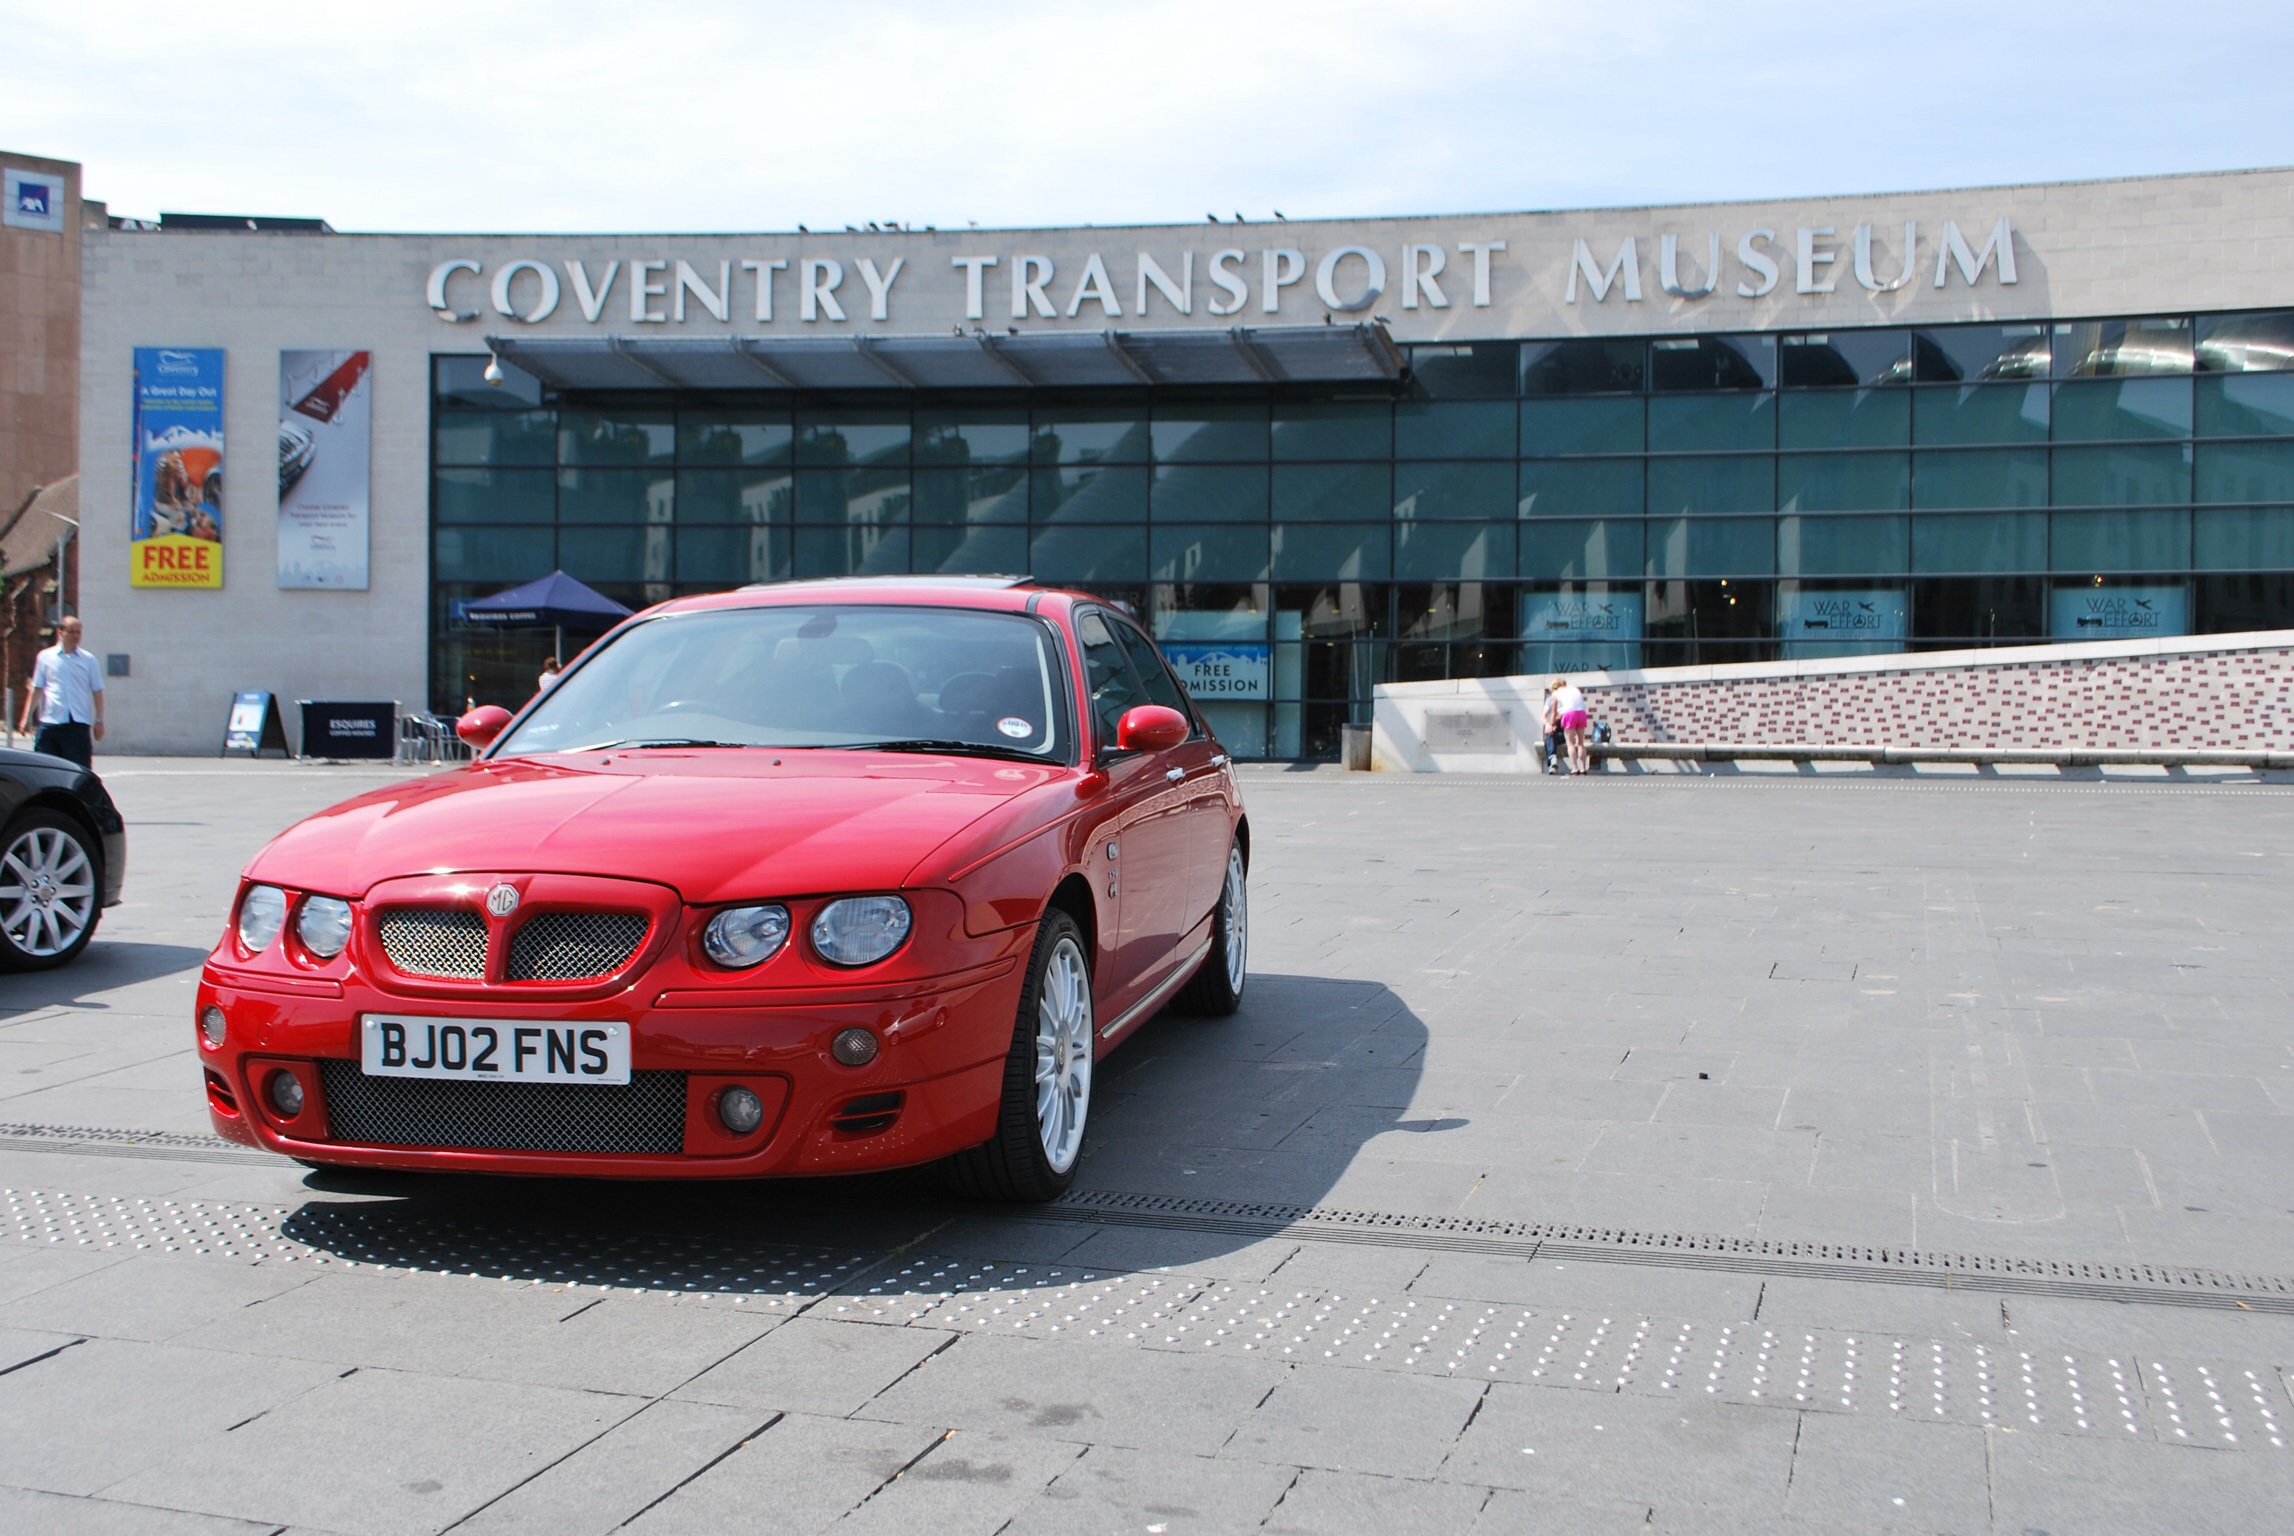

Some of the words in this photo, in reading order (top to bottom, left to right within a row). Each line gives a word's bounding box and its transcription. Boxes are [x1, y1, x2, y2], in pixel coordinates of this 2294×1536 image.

[425, 258, 906, 324] COVENTRY
[951, 241, 1507, 320] TRANSPORT
[1565, 216, 2019, 304] MUSEUM
[143, 545, 210, 571] FREE
[143, 573, 210, 583] ADMISSION
[1094, 590, 1196, 611] NTRNCE
[1813, 601, 1851, 616] WAR
[2086, 598, 2126, 614] WAR
[1554, 601, 1590, 617] WAR
[1570, 615, 1621, 630] EFFORT
[1830, 614, 1883, 630] EFFORT
[2104, 611, 2161, 627] EFFORT
[1195, 665, 1231, 677] FREE
[1177, 680, 1258, 692] DMISSION
[329, 719, 377, 730] ESQUIRES
[491, 889, 514, 911] MG
[380, 1022, 499, 1070] BJ02
[513, 1027, 609, 1075] FNS
